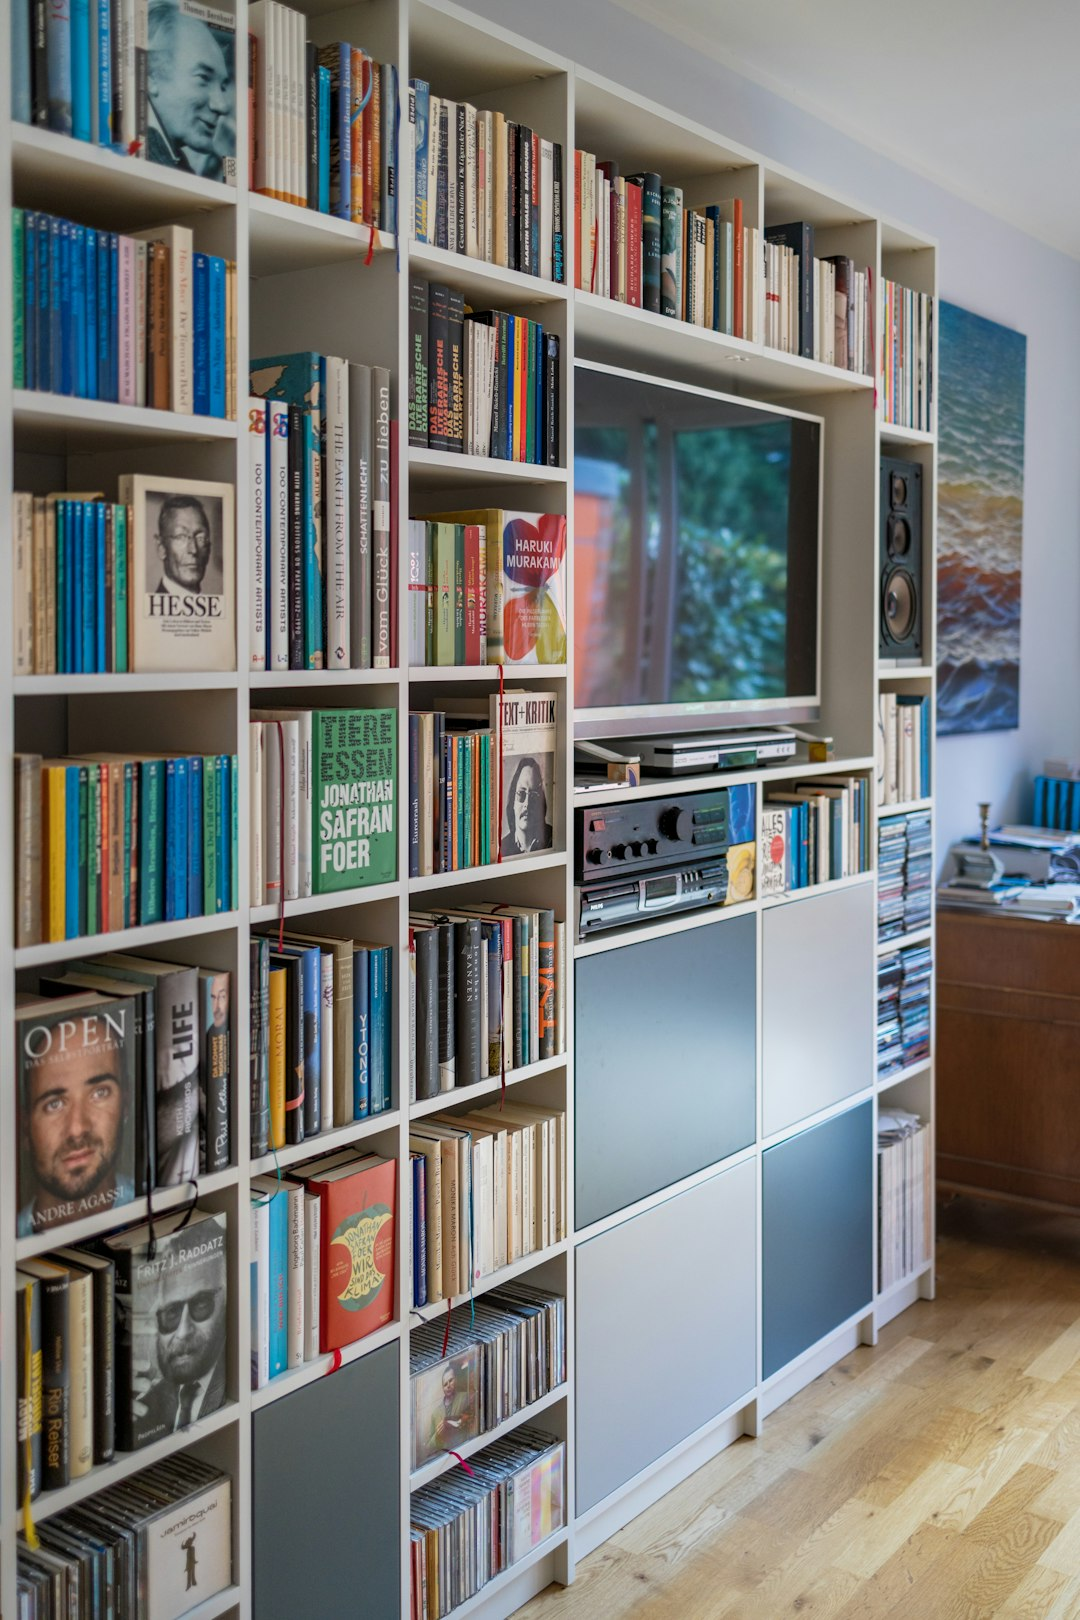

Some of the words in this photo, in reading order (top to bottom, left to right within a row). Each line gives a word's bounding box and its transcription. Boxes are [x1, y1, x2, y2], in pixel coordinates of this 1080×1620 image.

[101, 36, 109, 68] NUNEZ
[101, 71, 109, 102] SIGRID
[343, 133, 352, 161] Claire
[458, 168, 466, 179] Die
[458, 182, 466, 214] Bufalino
[458, 215, 466, 249] Gesualdo
[178, 311, 188, 329] Der
[197, 337, 206, 367] Mayer
[213, 337, 222, 367] Mayer
[197, 371, 206, 396] Hans
[213, 370, 222, 395] Hans
[375, 386, 389, 450] lieben
[408, 402, 416, 431] DAS
[335, 422, 345, 455] THE
[255, 463, 263, 486] 100
[279, 466, 287, 488] 100
[293, 471, 302, 490] KEITH
[335, 458, 345, 508] EARTH
[375, 459, 389, 484] zu
[293, 492, 302, 516] HARING
[360, 459, 368, 555] SCHATTENLICHT
[255, 488, 263, 584] CONTEMPORARY
[279, 490, 287, 585] CONTEMPORARY
[293, 521, 302, 553] EDITIONS
[335, 512, 345, 555] FROM
[515, 539, 553, 554] HARUKI
[293, 557, 302, 567] ON
[335, 559, 345, 592] THE
[375, 546, 389, 603] Glück
[507, 554, 562, 570] MURAKAMI
[293, 569, 302, 591] PAPER
[479, 547, 487, 637] MURAKAMI
[149, 594, 222, 618] HESSE
[255, 587, 263, 633] ARTISTS
[279, 588, 287, 633] ARTISTS
[335, 594, 345, 620] AIR
[375, 610, 389, 653] vom
[320, 713, 393, 748] TIERE
[320, 748, 393, 783] ESSEN
[148, 778, 158, 823] Brasilien
[320, 779, 393, 808] JONATHAN
[206, 830, 214, 847] Der
[320, 803, 393, 842] SAFRAN
[320, 838, 371, 874] FOER
[466, 945, 474, 1002] RANZEN
[24, 1009, 126, 1058] OPEN
[172, 1001, 193, 1060] LIFE
[184, 1081, 192, 1133] RICHARDS
[28, 1200, 75, 1227] ANDRE
[78, 1186, 125, 1212] AGASSI
[291, 1195, 300, 1234] Bachmann
[344, 1218, 382, 1244] JONATHAN
[137, 1259, 167, 1280] FRITZ
[169, 1254, 178, 1270] J.
[179, 1236, 224, 1264] RADDATZ
[291, 1234, 300, 1270] Ingeborg
[352, 1256, 374, 1275] WIR
[344, 1274, 383, 1299] KLIMA!
[48, 1388, 63, 1415] Rio
[48, 1418, 63, 1469] Reiser
